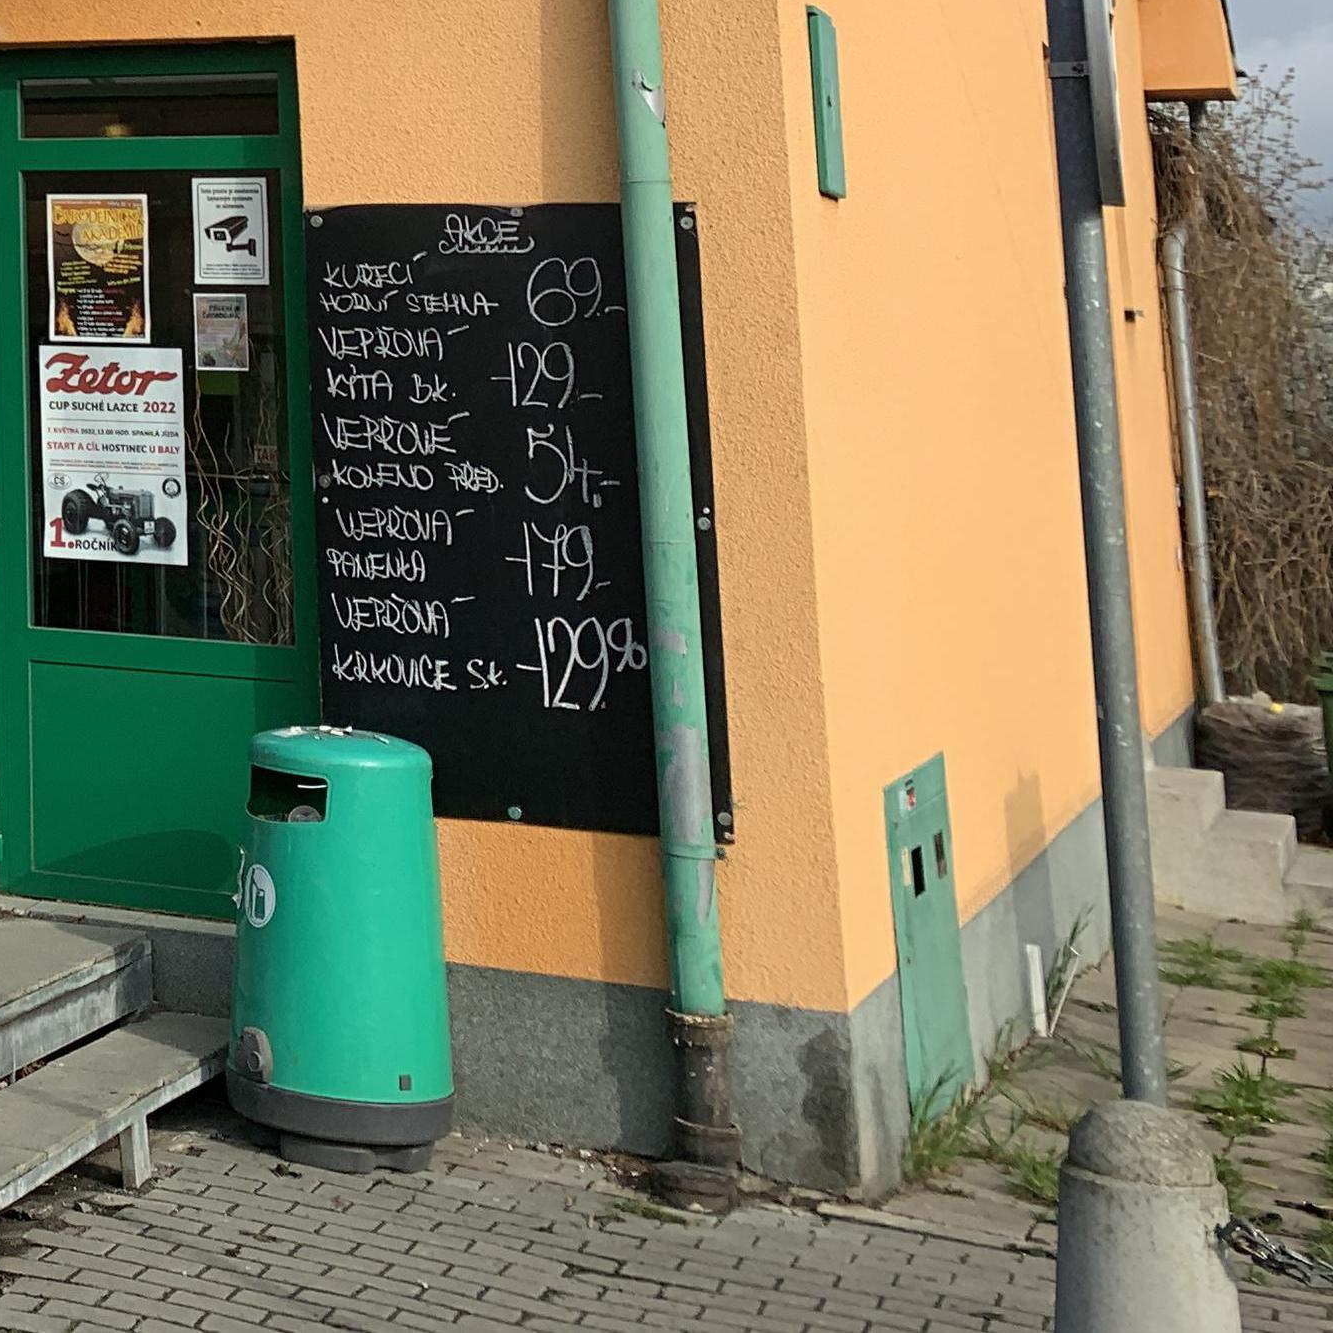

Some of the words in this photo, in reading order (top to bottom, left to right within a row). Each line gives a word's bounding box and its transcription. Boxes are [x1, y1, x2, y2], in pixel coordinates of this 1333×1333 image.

[443, 213, 520, 247] AKCE
[45, 352, 178, 396] Zetor
[49, 401, 70, 410] CUP
[72, 399, 104, 412] SUCHÉ
[107, 402, 139, 413] LAZCE
[143, 401, 176, 414] 2022
[47, 441, 76, 450] START
[78, 442, 84, 450] A
[86, 440, 99, 452] CÍL
[101, 444, 148, 454] HOSTINEC
[149, 445, 155, 453] U
